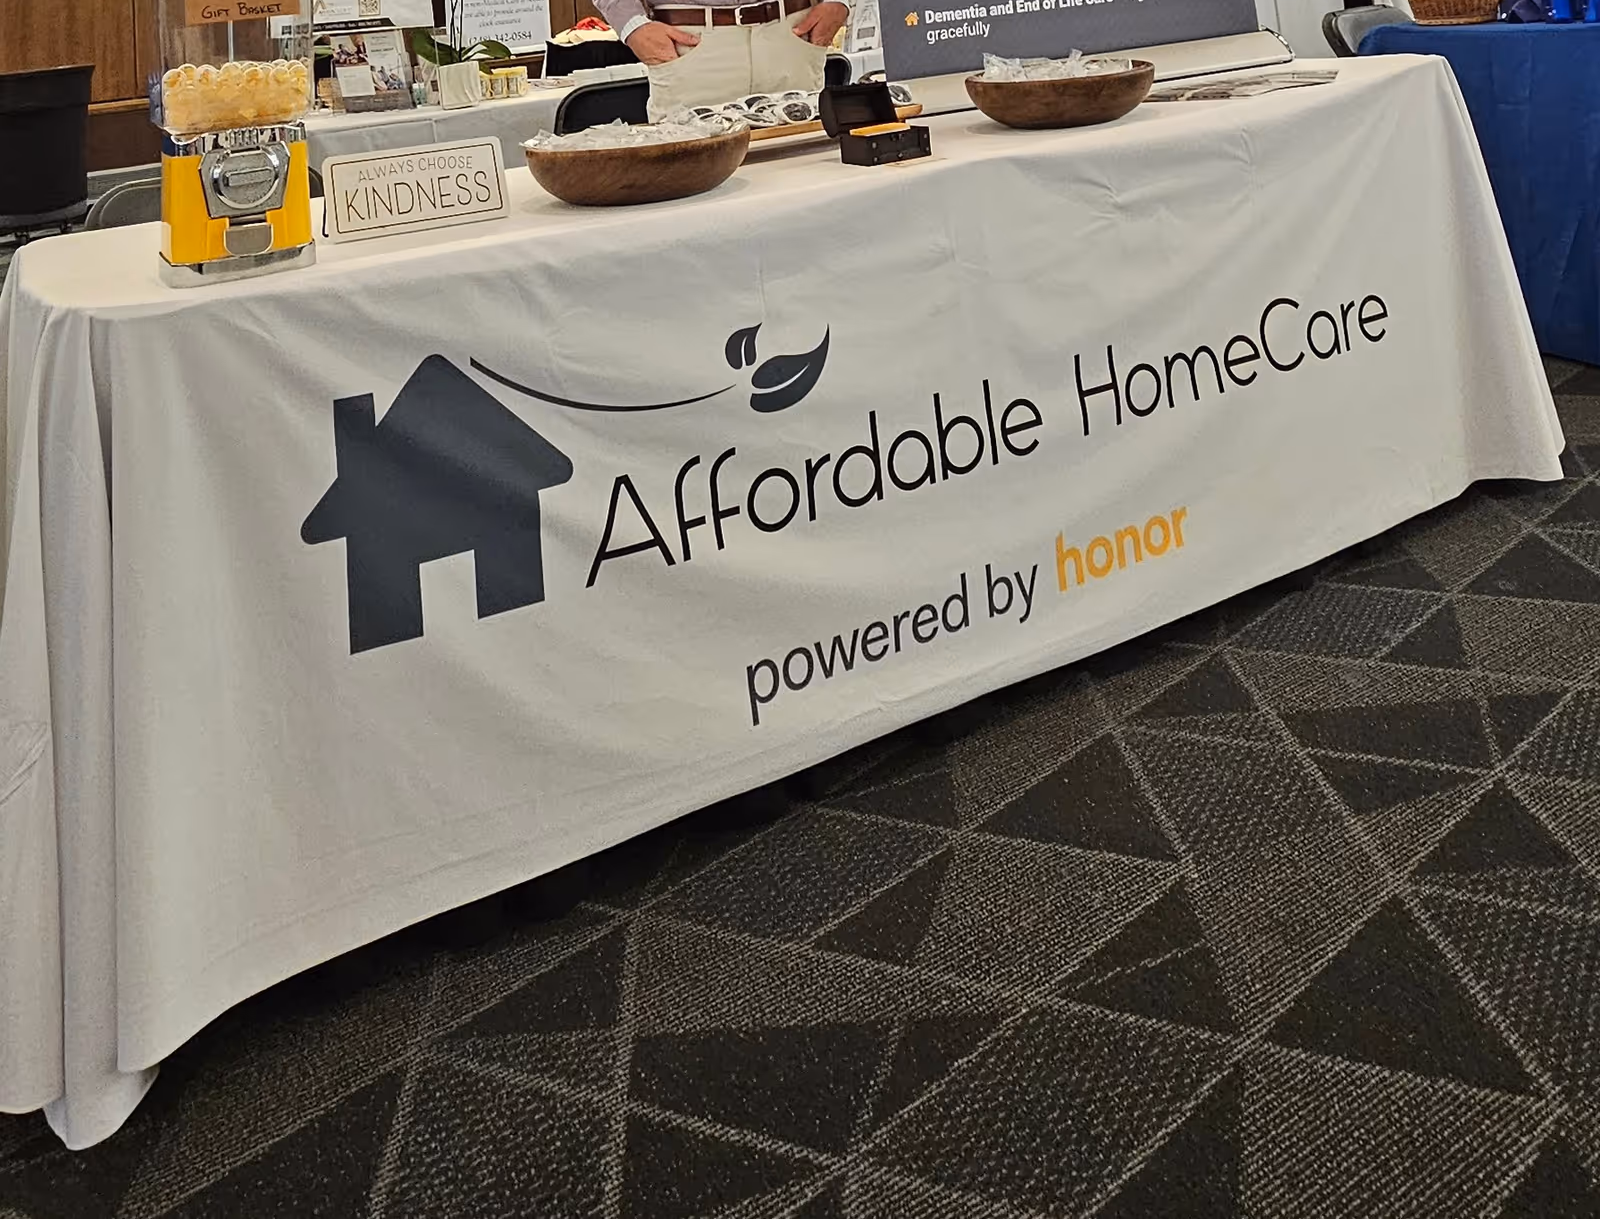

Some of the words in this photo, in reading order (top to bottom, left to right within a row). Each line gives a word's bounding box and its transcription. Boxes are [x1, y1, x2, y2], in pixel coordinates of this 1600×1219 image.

[202, 5, 230, 19] GIFT
[237, 2, 282, 16] BASKET
[925, 4, 987, 24] Dementia
[990, 0, 1014, 17] and
[926, 21, 990, 44] gracefully
[358, 159, 414, 183] ALWAYS
[418, 156, 473, 171] CHOOSE
[345, 170, 491, 222] KINDNESS
[585, 377, 1044, 588] Affordable
[1074, 292, 1389, 436] HomeCare
[744, 571, 971, 725] powered
[986, 562, 1038, 624] by
[1055, 505, 1188, 592] honor
